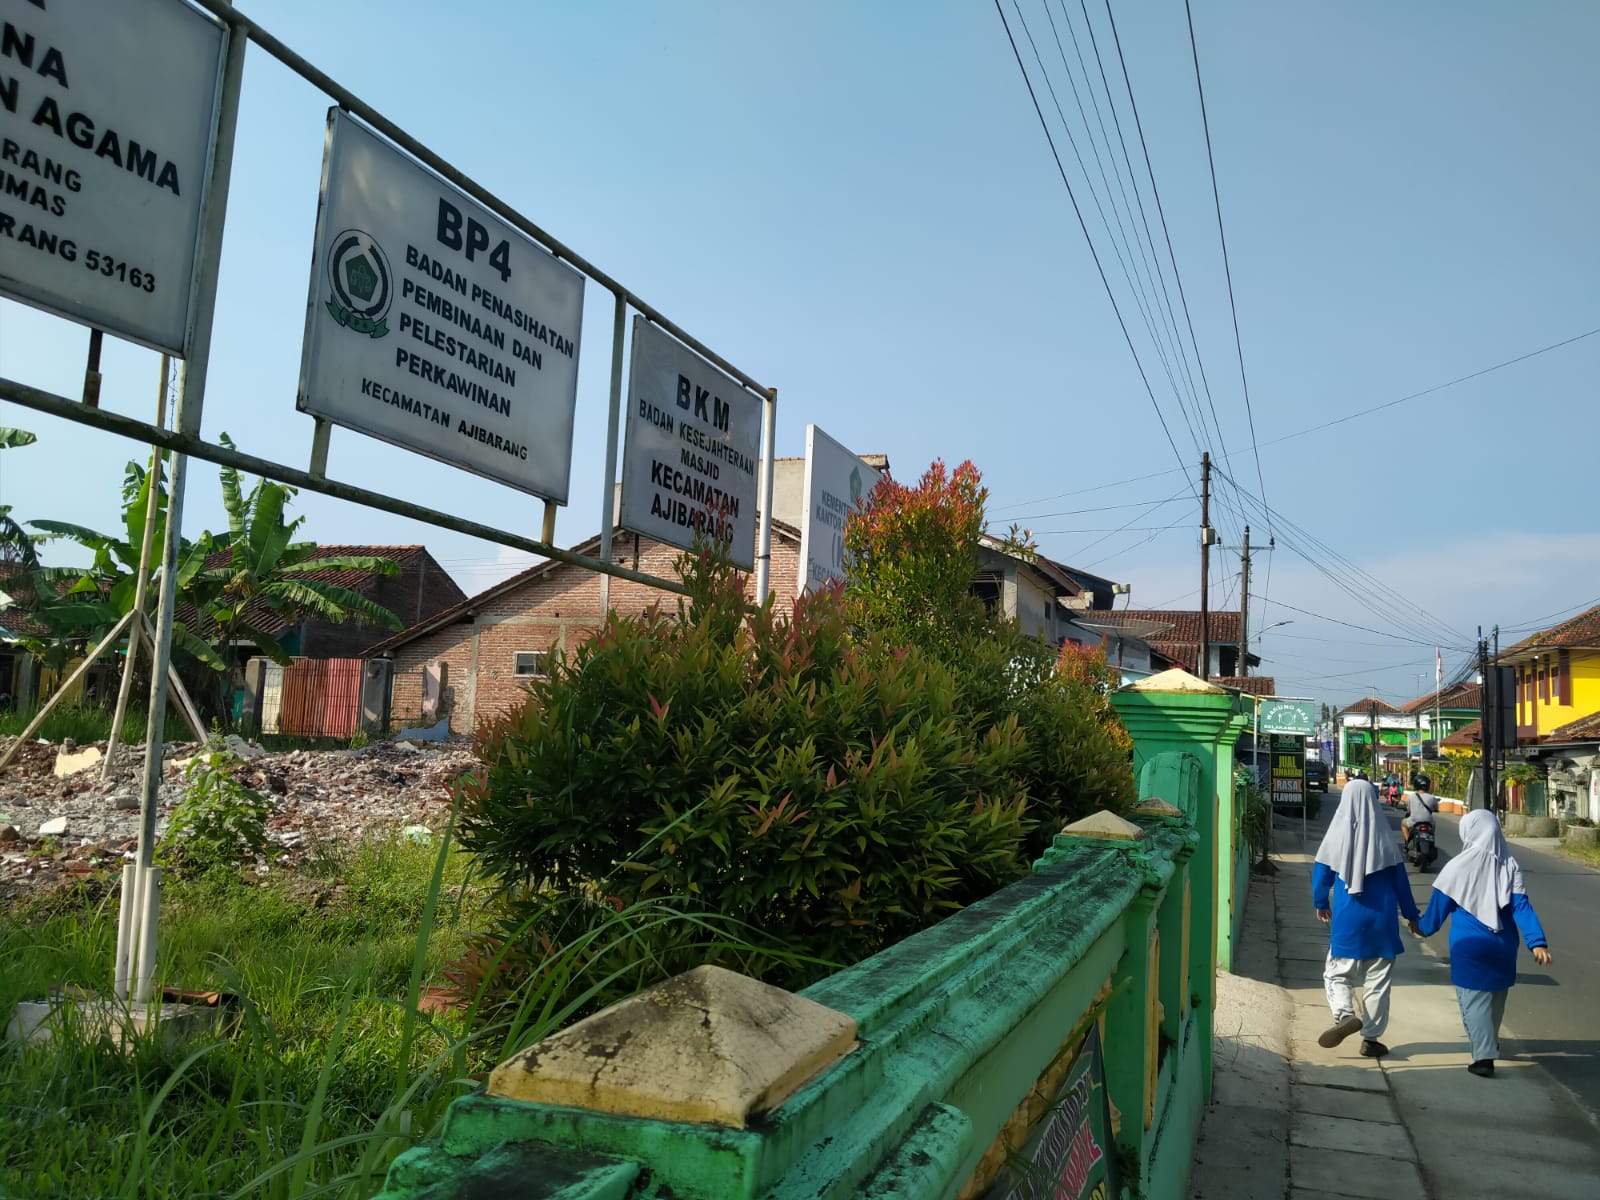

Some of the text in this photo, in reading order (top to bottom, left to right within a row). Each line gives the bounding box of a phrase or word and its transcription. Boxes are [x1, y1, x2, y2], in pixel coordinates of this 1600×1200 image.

[2, 138, 82, 193] RANG
[32, 96, 180, 196] AGAMA
[85, 250, 155, 293] 53163
[437, 197, 511, 283] BP4
[402, 278, 542, 370] PEMBINAAN DAN
[406, 244, 574, 359] BADAN PENASIHATAN
[396, 347, 511, 417] PERKAWINAN
[400, 312, 516, 387] PELESTARIAN
[361, 377, 528, 460] KECAMATAN AJIBARANG
[676, 373, 730, 433] BKM
[639, 398, 754, 477] BADAN KESEJAHTERAAN
[680, 447, 720, 481] MASJID
[651, 460, 740, 518] KECAMATAN
[651, 493, 734, 544] AJIBARANG
[1272, 792, 1303, 802] FLAVOUR
[1276, 779, 1298, 792] RASA
